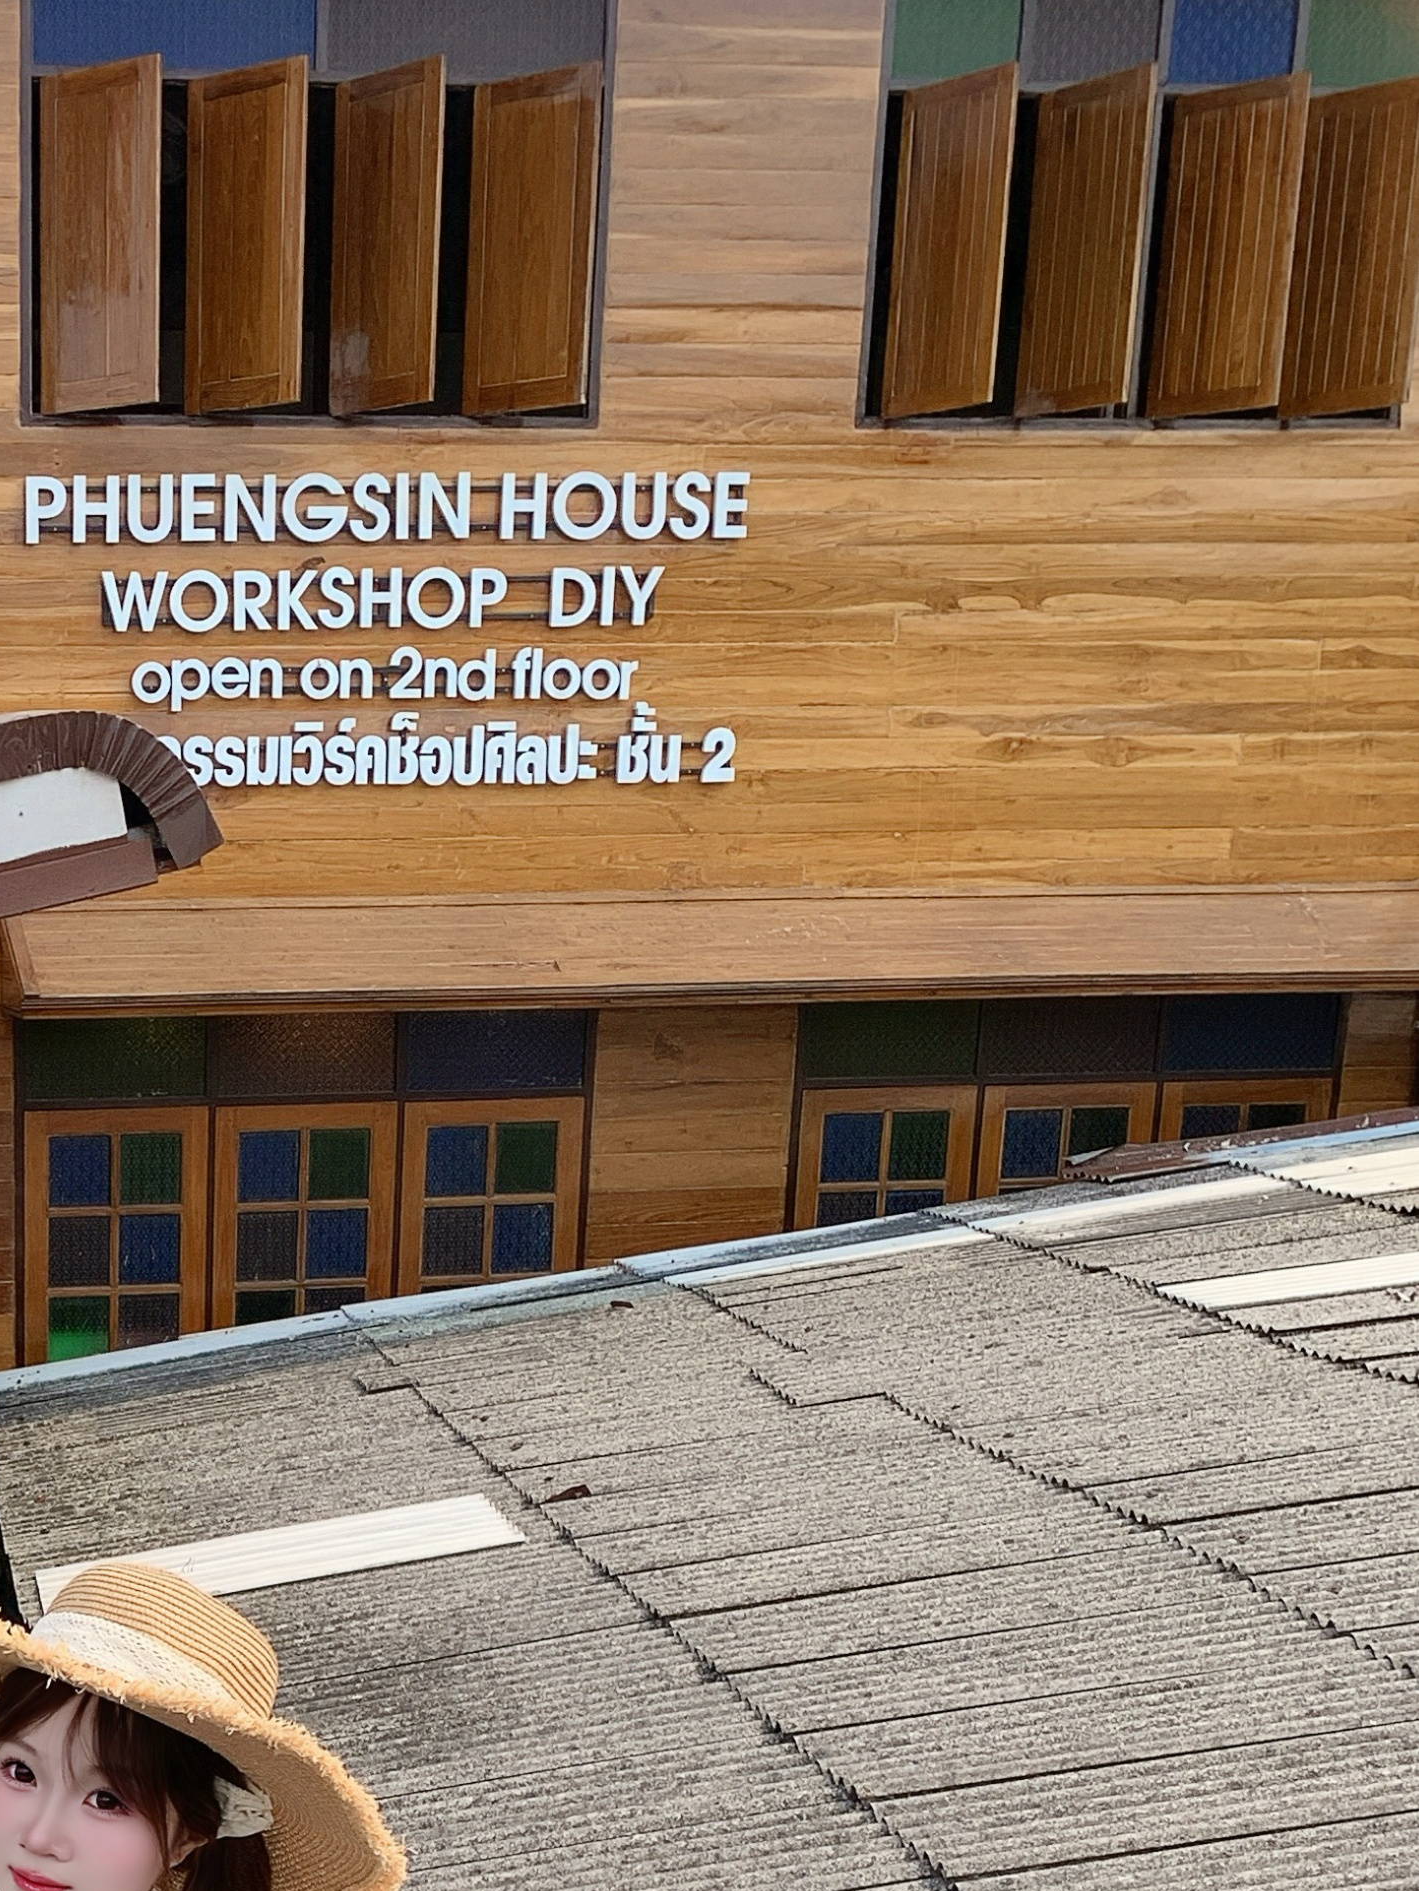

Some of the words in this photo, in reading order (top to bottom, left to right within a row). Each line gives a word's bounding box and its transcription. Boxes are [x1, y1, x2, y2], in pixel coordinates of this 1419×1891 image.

[24, 471, 471, 544] PHUENGSIN
[498, 471, 750, 541] HOUSE
[101, 566, 508, 632] WORKSHOP
[548, 565, 665, 628] DIY
[131, 656, 282, 711] open
[299, 657, 375, 699] on
[389, 646, 496, 700] 2nd
[512, 647, 639, 700] floor
[616, 702, 680, 784] ชั้น
[701, 727, 736, 783] 2
